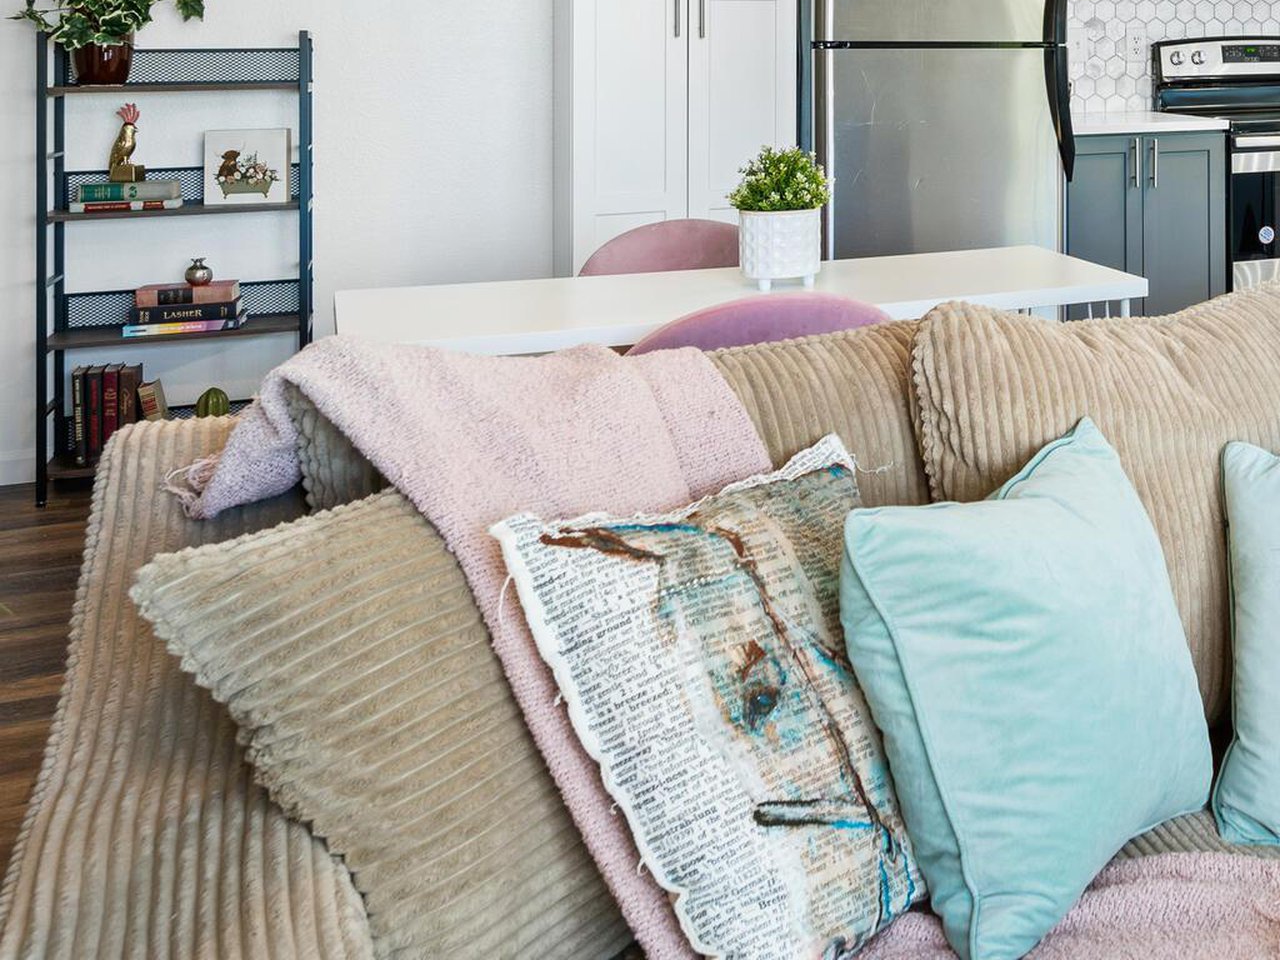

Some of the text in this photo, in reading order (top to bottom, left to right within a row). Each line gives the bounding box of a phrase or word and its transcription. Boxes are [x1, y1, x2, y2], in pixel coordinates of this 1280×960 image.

[163, 309, 203, 320] LASHER
[595, 616, 632, 639] ground
[612, 687, 648, 710] breeze
